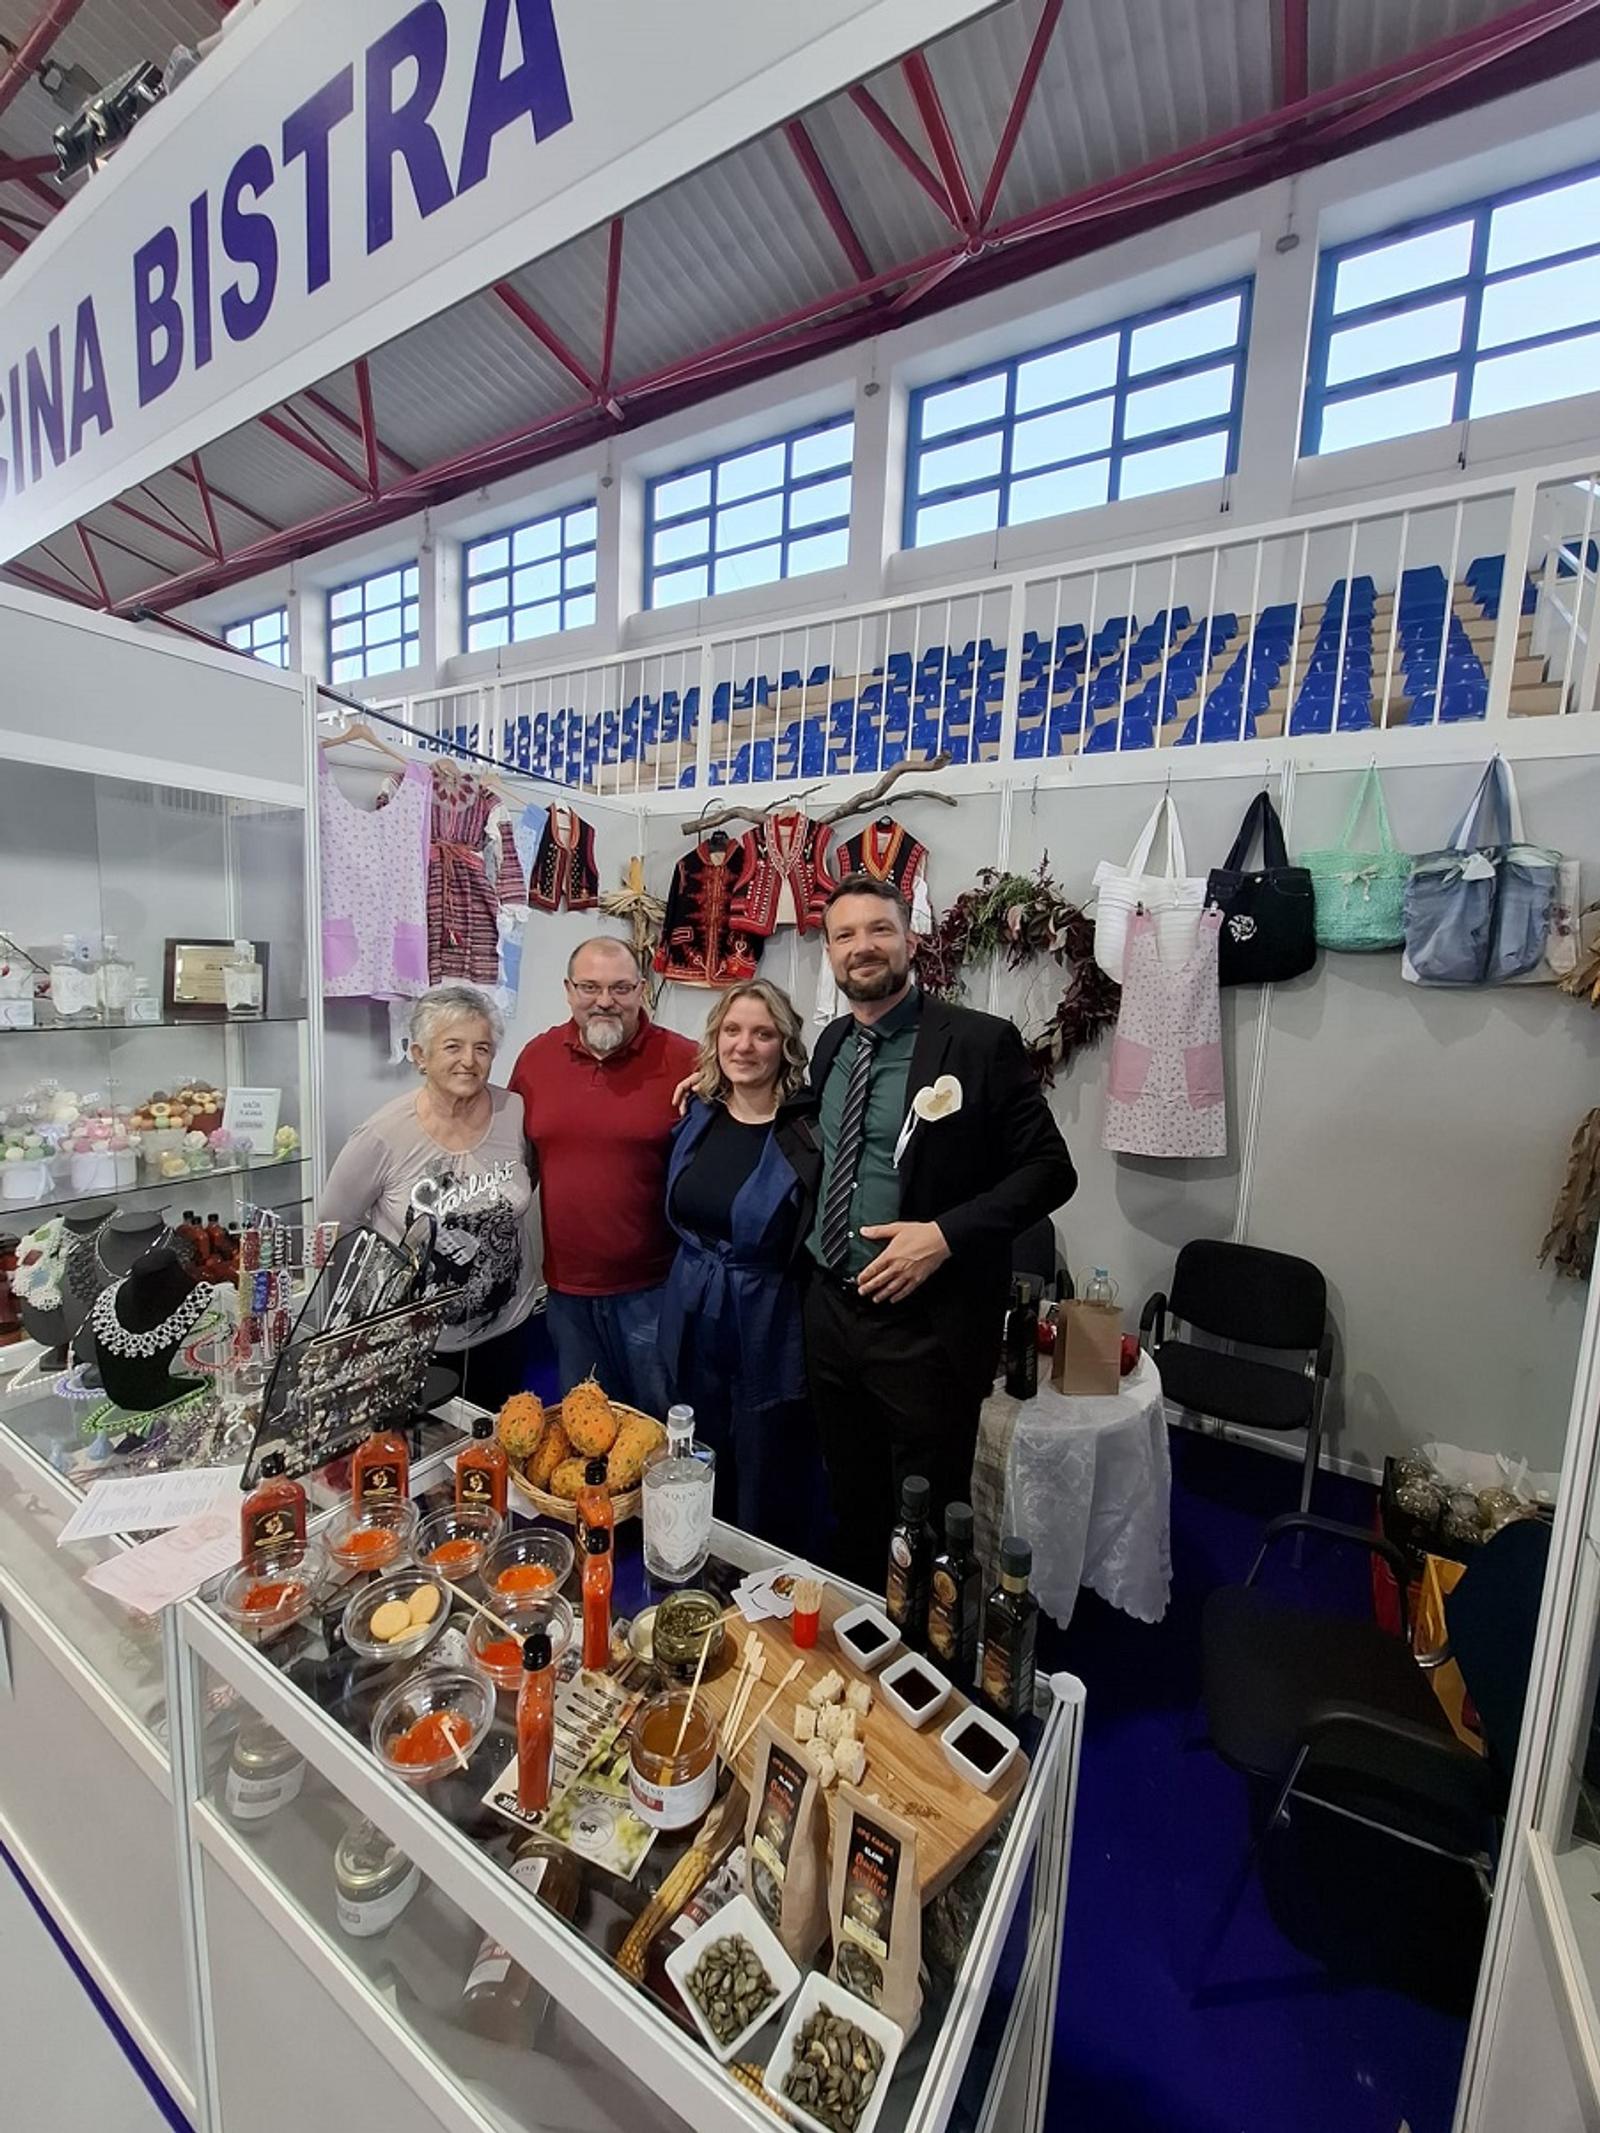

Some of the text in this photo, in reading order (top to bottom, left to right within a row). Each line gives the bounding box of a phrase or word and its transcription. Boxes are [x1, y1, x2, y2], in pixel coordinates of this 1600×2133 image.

[0, 0, 573, 503] INA BISTRA
[411, 1160, 518, 1217] Starlight
